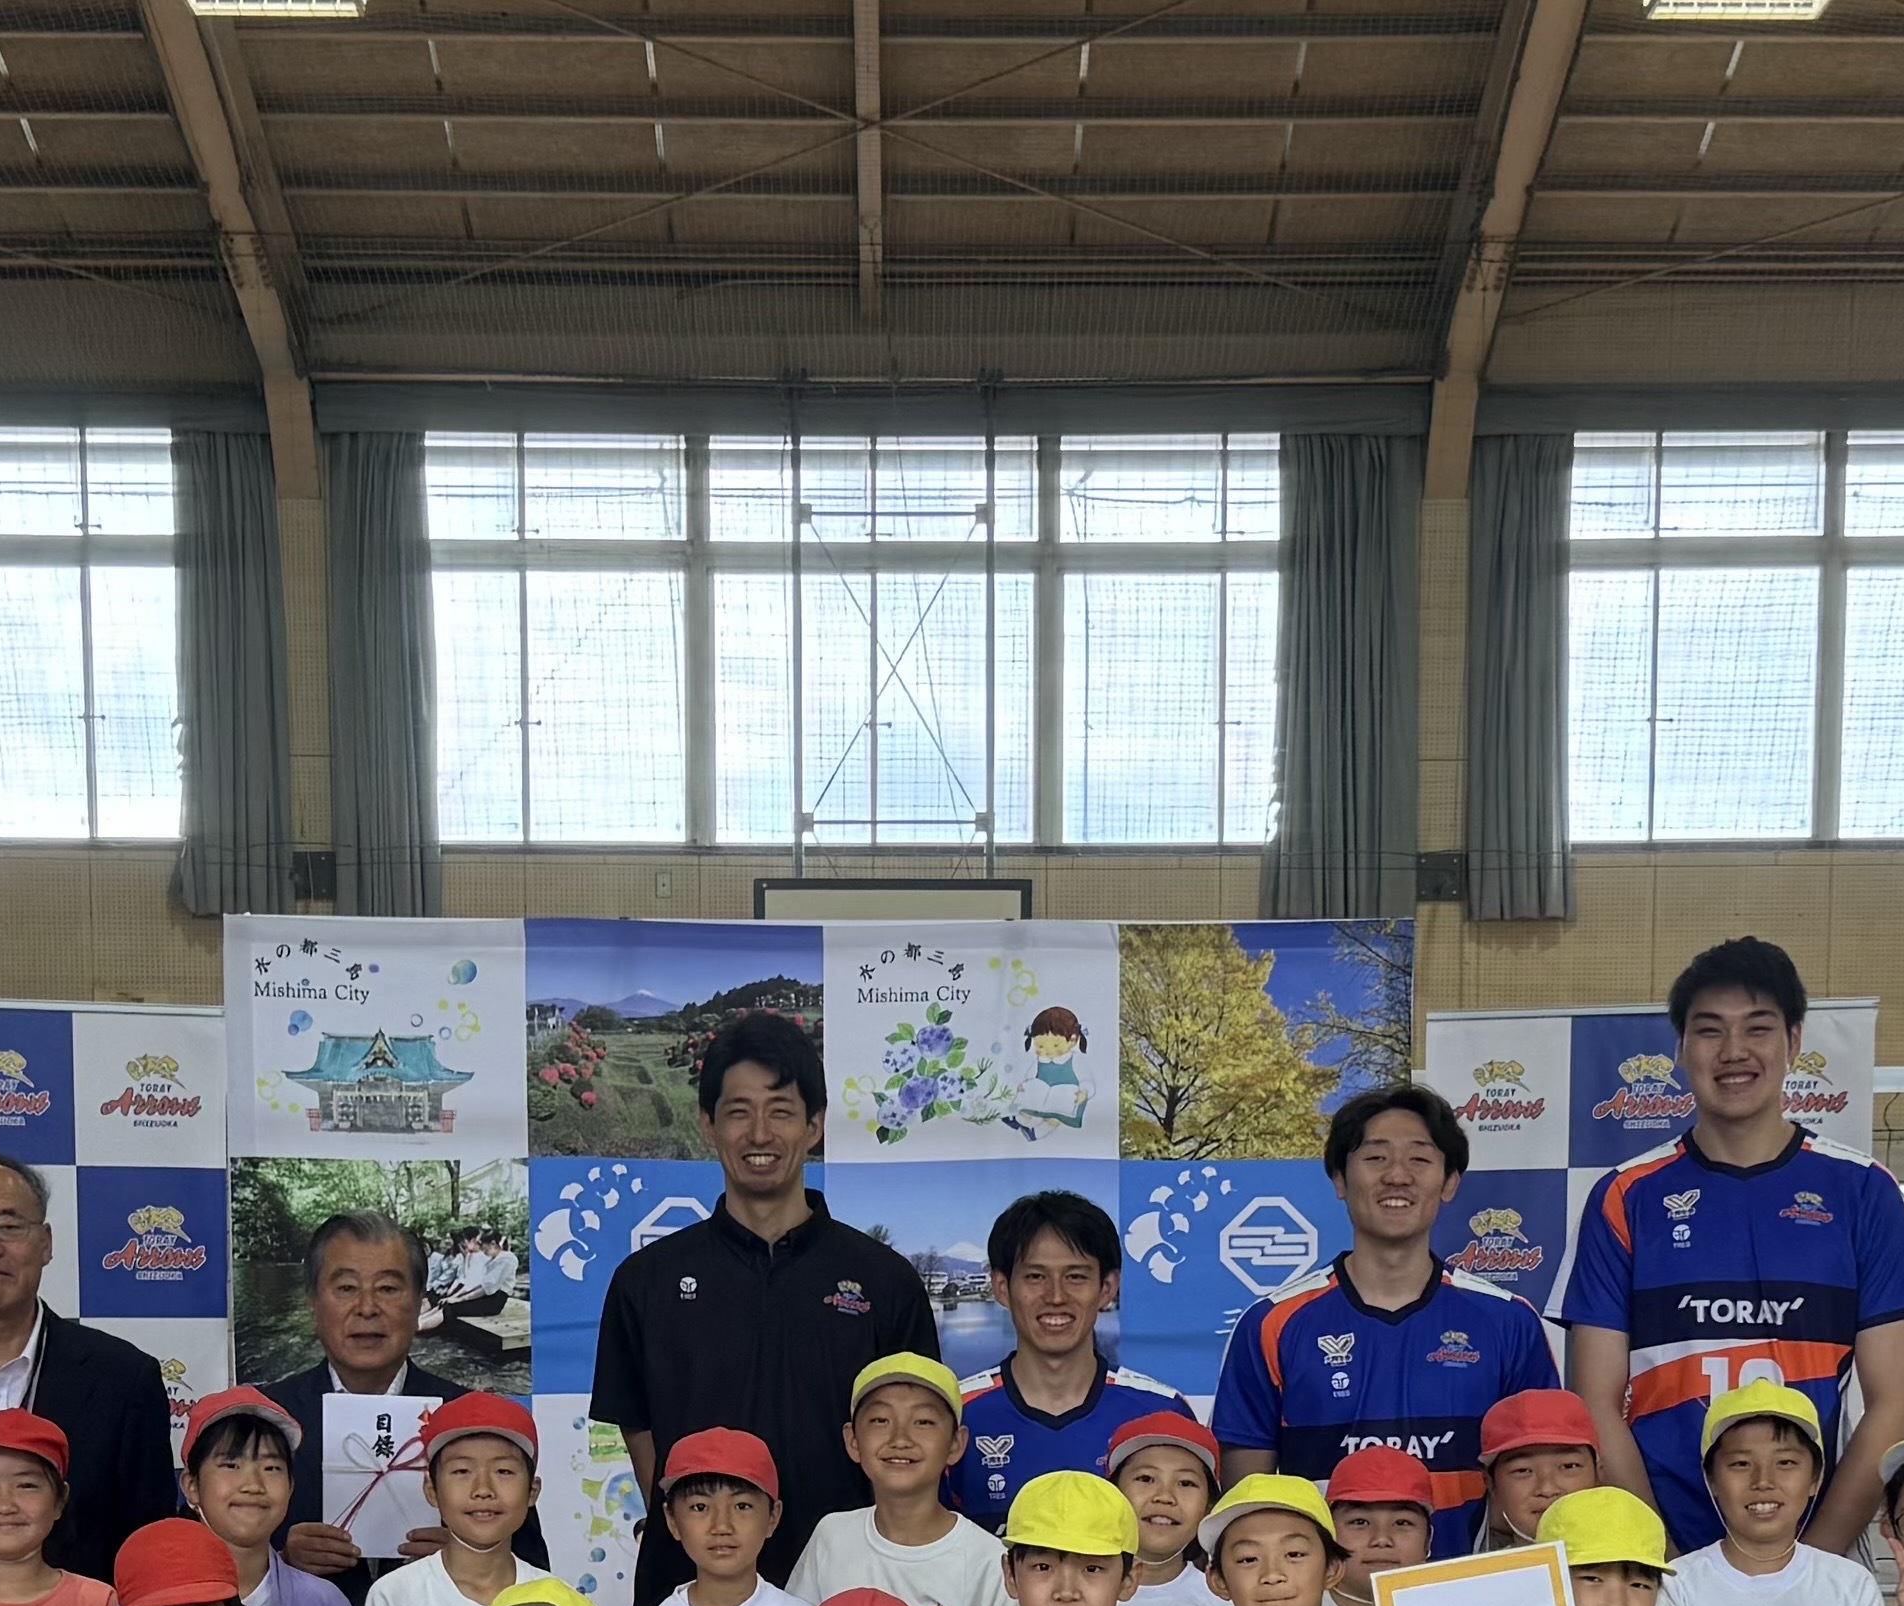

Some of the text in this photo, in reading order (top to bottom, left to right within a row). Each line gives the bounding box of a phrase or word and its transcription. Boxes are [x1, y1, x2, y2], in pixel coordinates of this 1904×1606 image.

[254, 981, 370, 1005] Mishima City
[857, 985, 971, 1005] Mishima City
[140, 1083, 172, 1093] TORAY
[1631, 1083, 1667, 1094] TORAY
[1784, 1080, 1819, 1091] TORAY
[1486, 1088, 1516, 1098] TORAY
[142, 1234, 178, 1246] TORAY
[372, 1412, 396, 1459] 目録
